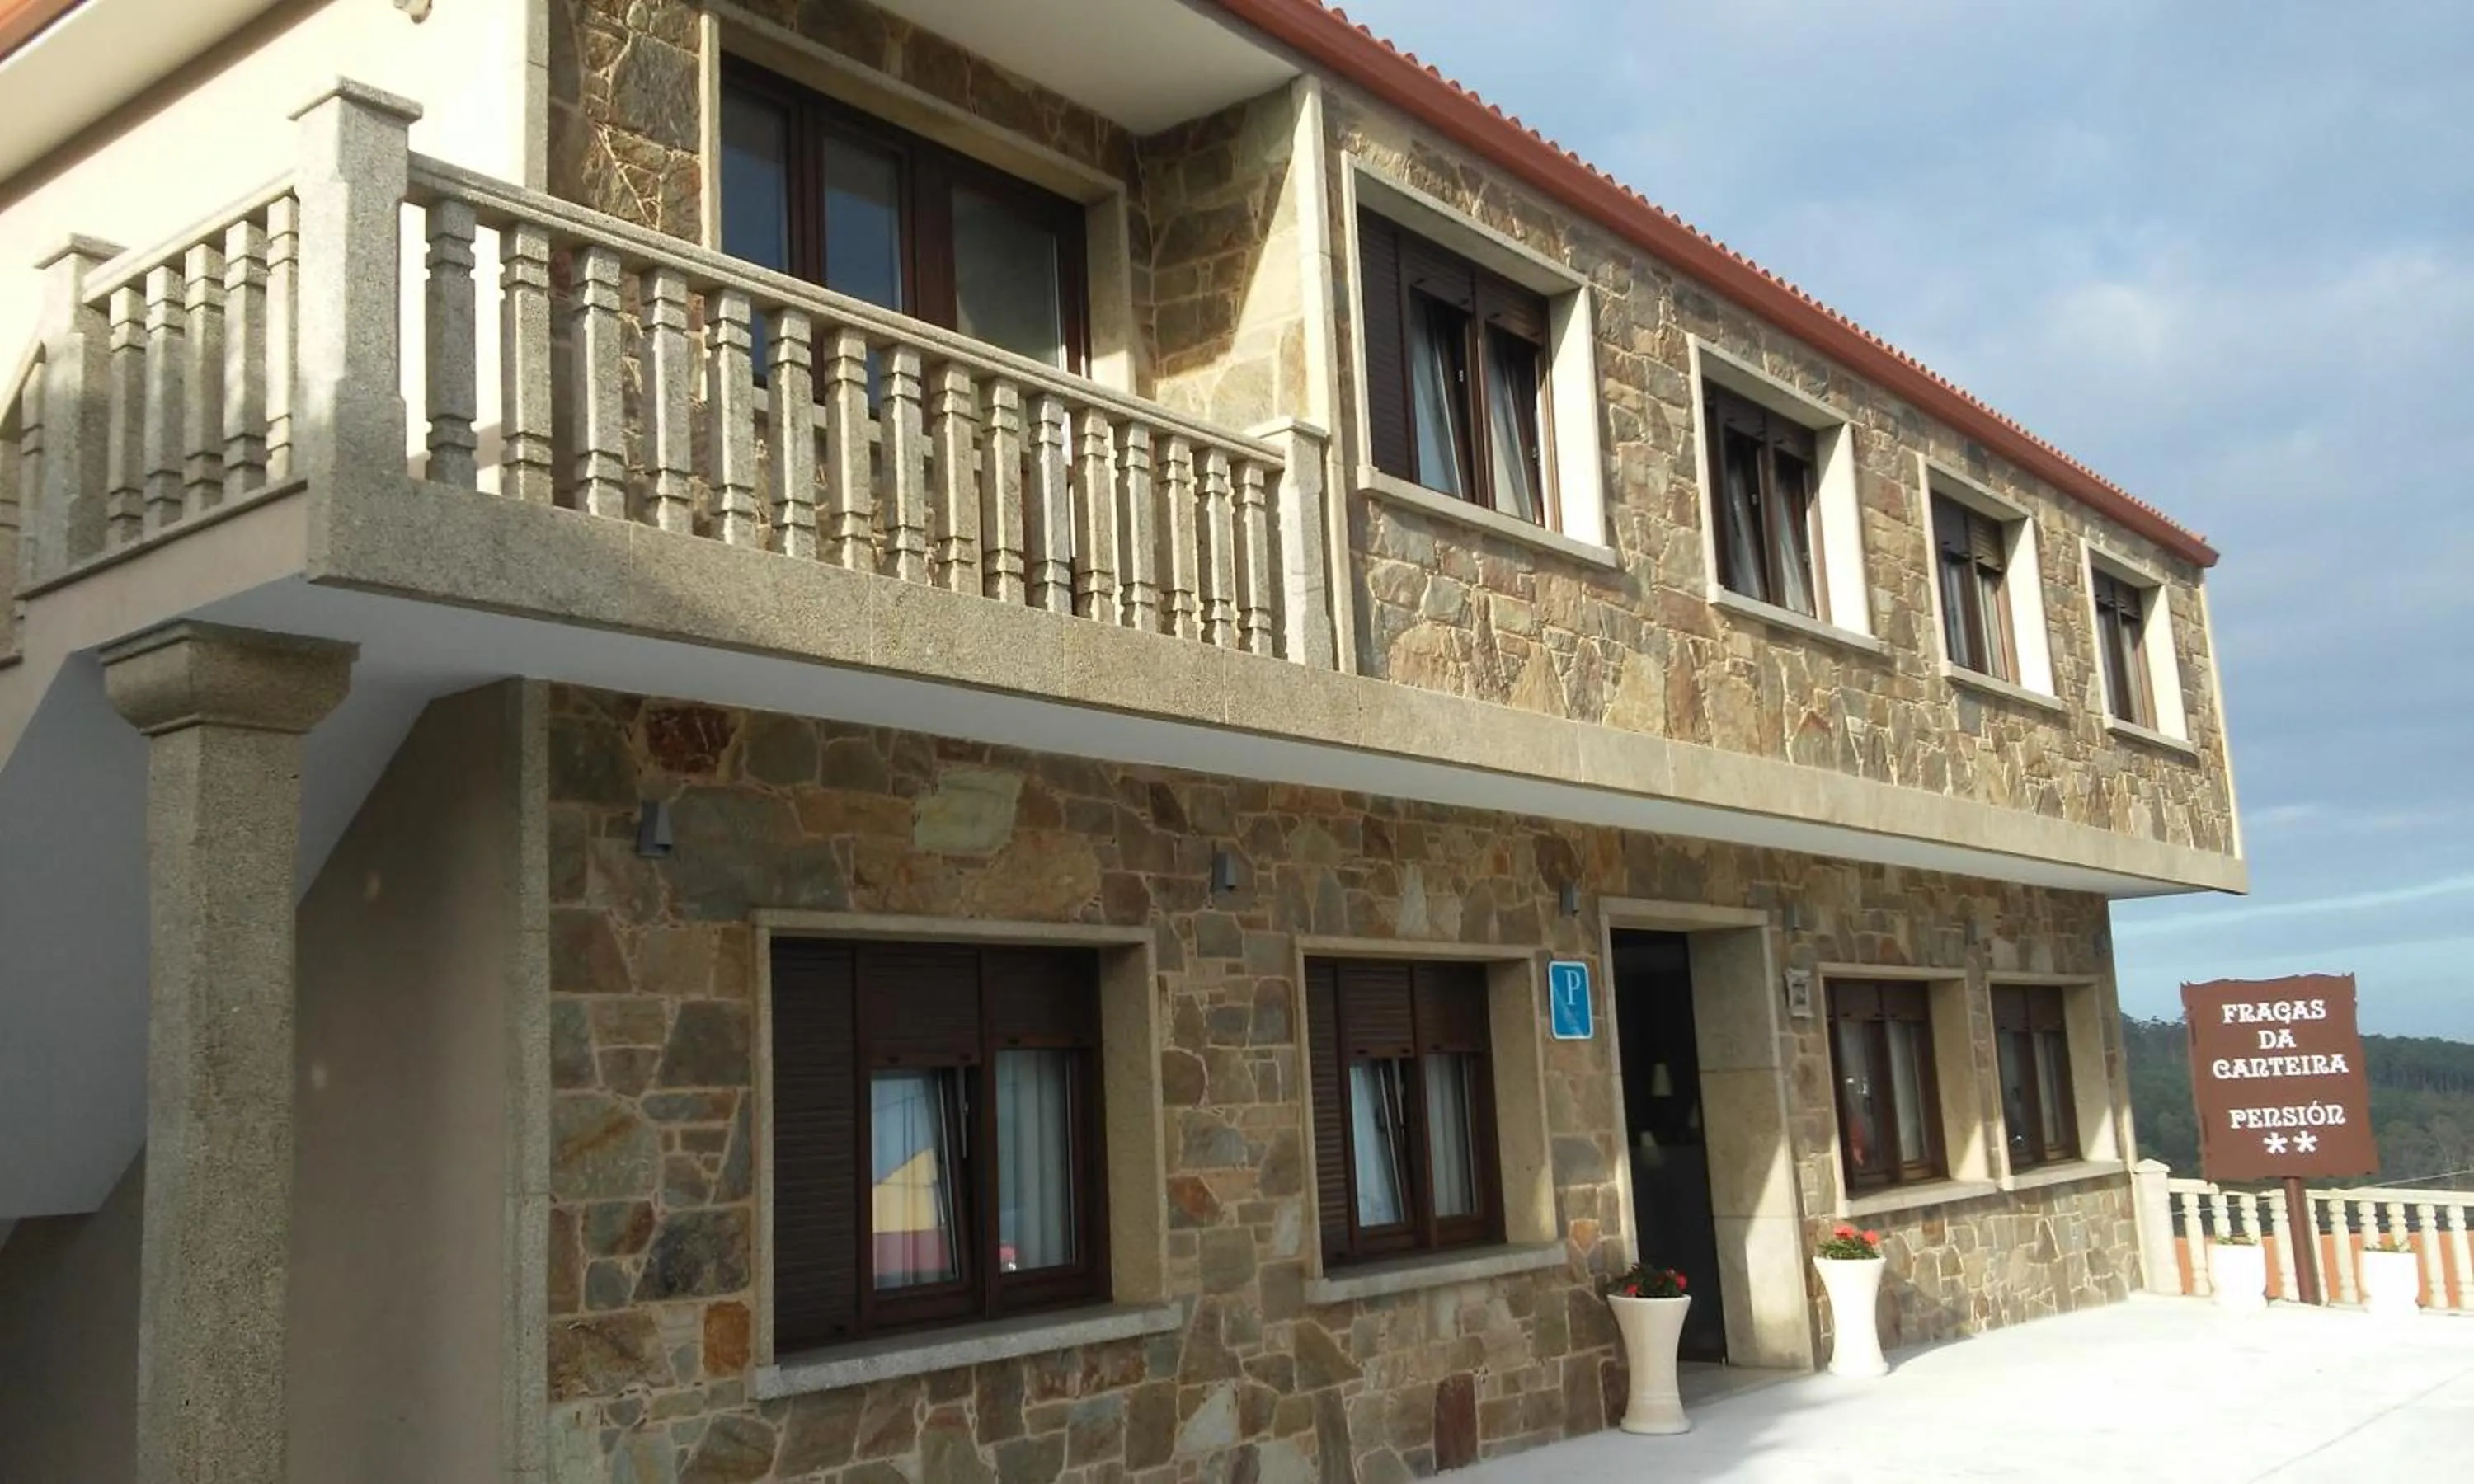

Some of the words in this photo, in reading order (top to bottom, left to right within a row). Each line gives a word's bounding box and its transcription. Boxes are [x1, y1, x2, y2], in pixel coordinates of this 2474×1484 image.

[1564, 969, 1582, 1006] P
[2222, 998, 2326, 1024] FRAGAS
[2257, 1028, 2297, 1050] DA
[2212, 1054, 2349, 1079] CANTEIRA
[2229, 1100, 2346, 1129] PENSIÓN
